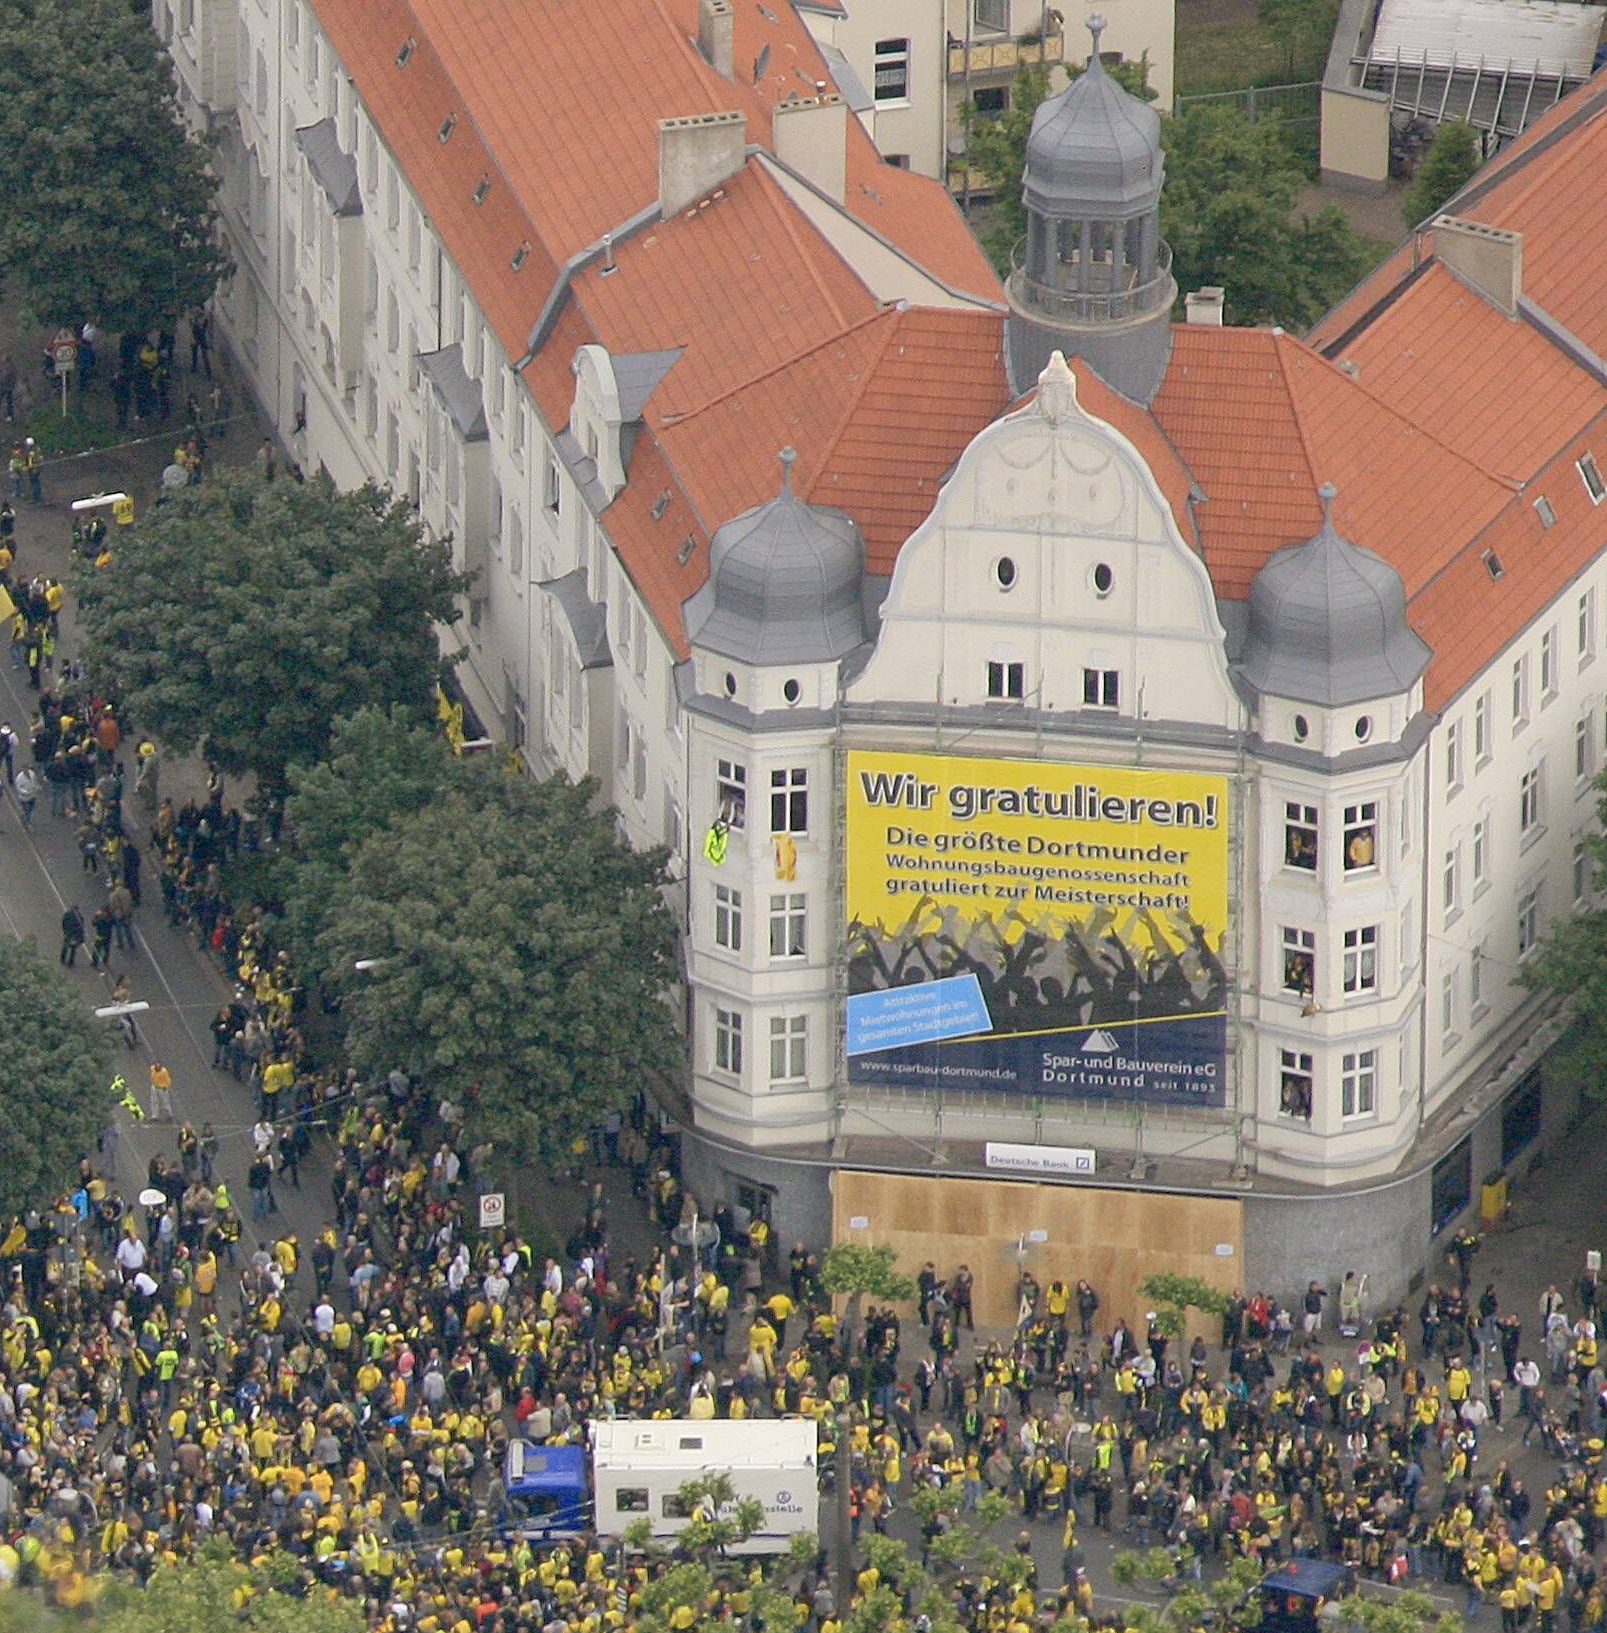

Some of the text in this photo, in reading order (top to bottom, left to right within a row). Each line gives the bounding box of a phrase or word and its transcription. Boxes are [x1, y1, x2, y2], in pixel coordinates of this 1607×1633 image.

[860, 771, 1218, 829] Wir gratulieren!
[887, 827, 1189, 864] Die größte Dortmunder
[886, 853, 1189, 887] Wohnungsbaugenossenschaft
[886, 878, 1189, 909] gratuliert zur Meisterschaft!
[860, 1061, 1017, 1080] www.sparbau-dortmund.de
[1043, 1053, 1216, 1077] Spar- und Bauverein eG
[1043, 1069, 1144, 1087] Dortmund
